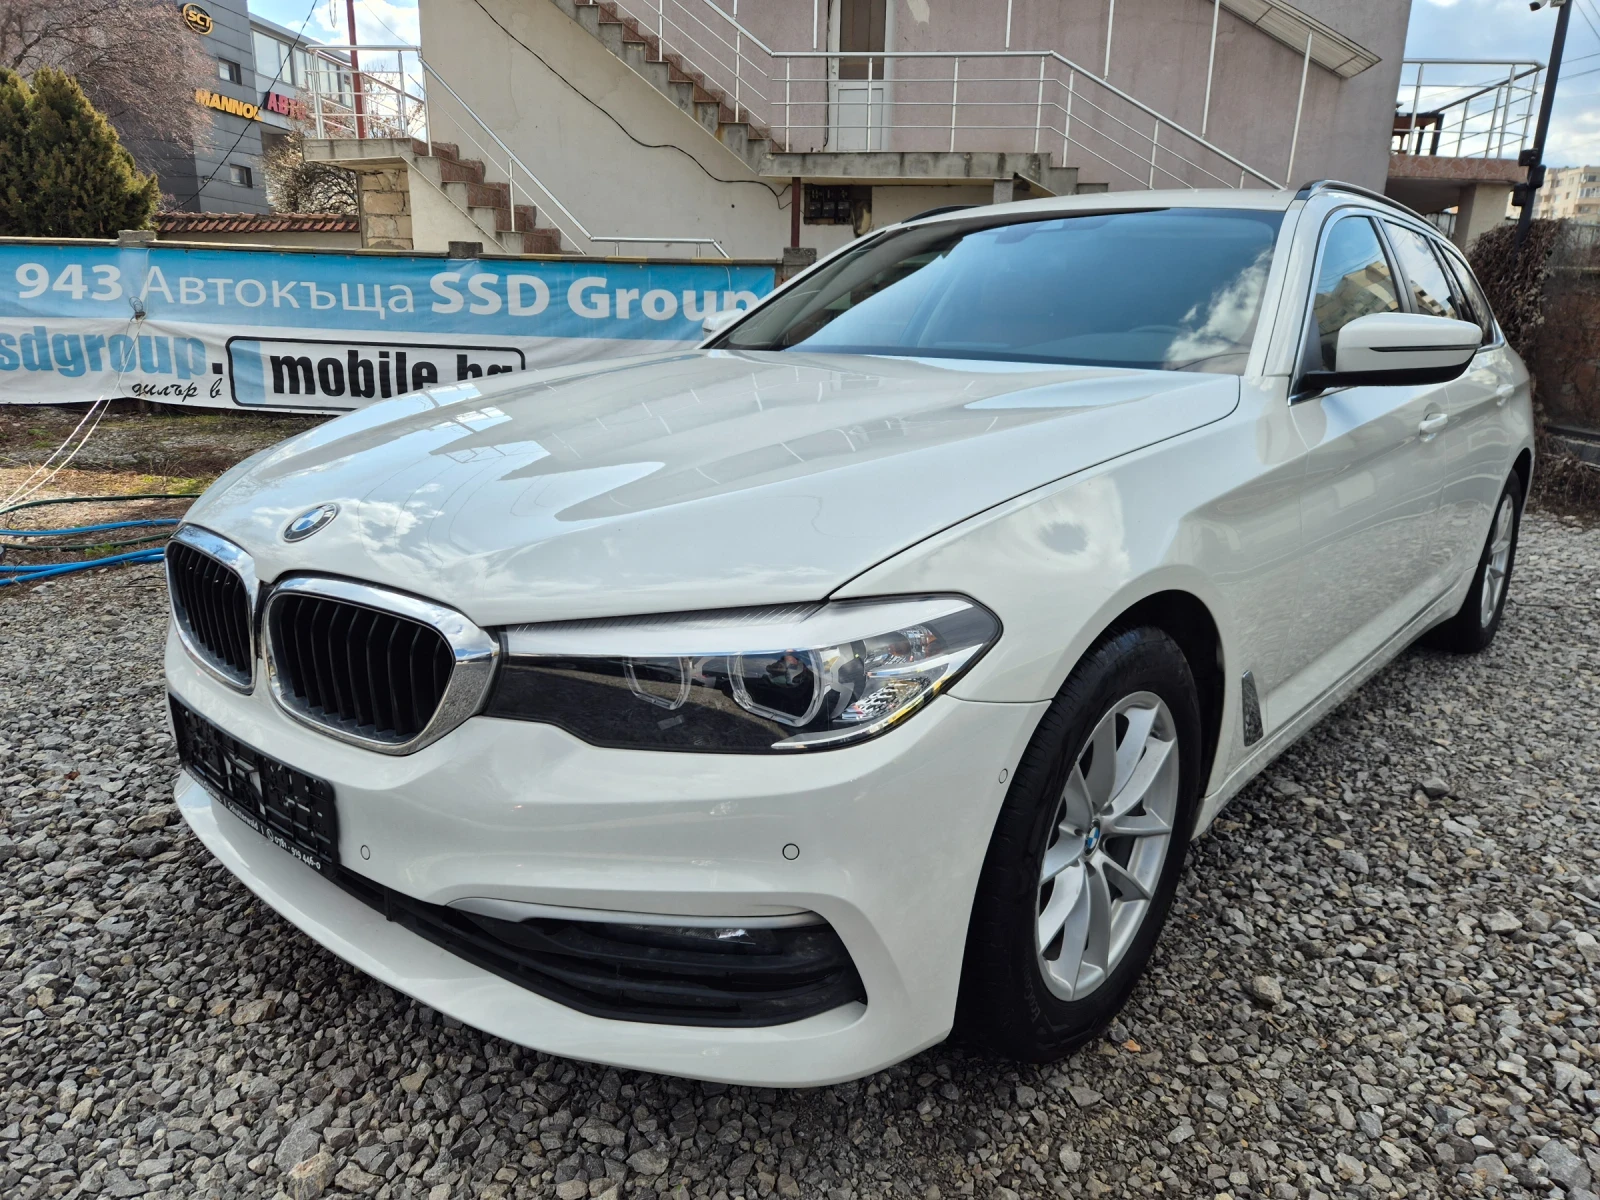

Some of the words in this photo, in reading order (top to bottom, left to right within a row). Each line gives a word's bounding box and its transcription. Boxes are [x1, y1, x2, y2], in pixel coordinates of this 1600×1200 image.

[187, 10, 212, 28] SCT
[195, 88, 263, 122] MANNOL
[15, 262, 123, 301] 943
[139, 265, 415, 321] Автокъща
[429, 271, 550, 317] SSD
